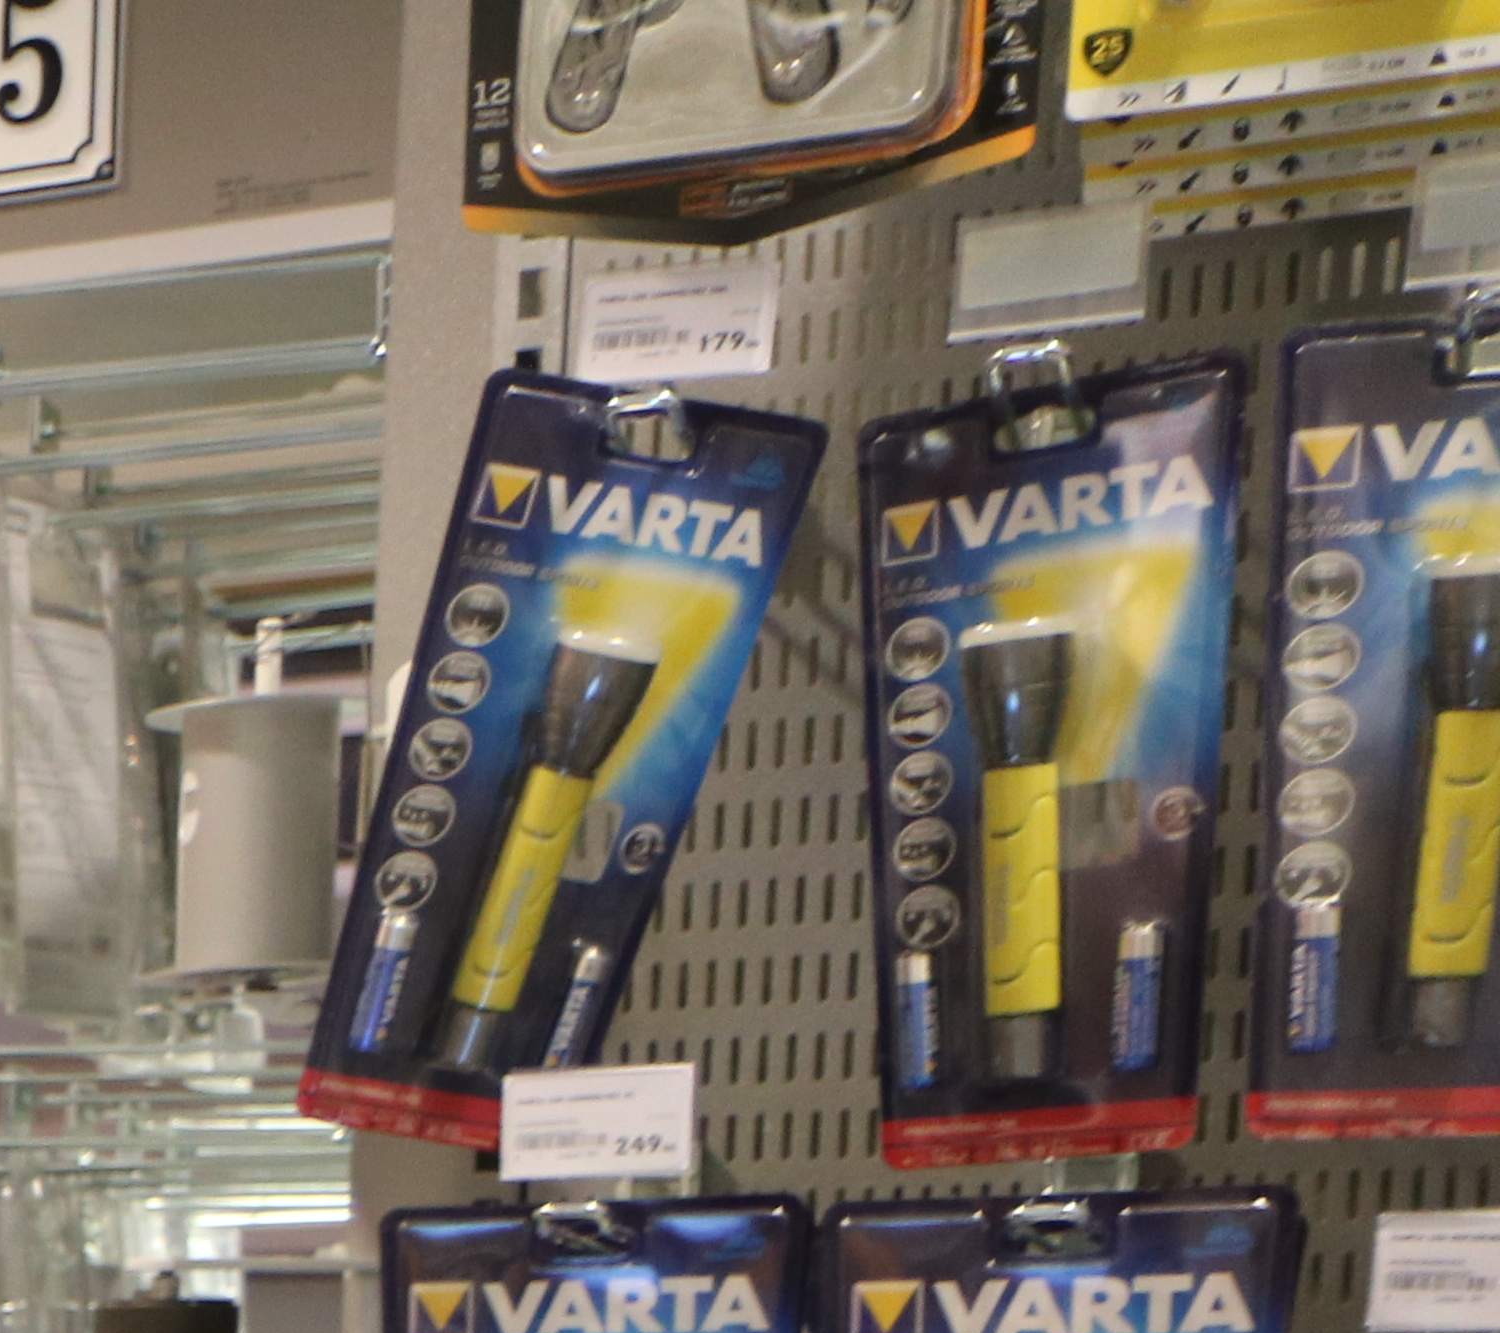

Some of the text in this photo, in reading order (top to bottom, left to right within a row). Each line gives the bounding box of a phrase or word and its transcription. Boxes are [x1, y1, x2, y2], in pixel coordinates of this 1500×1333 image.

[1091, 33, 1125, 64] 25
[473, 77, 512, 108] 12
[548, 474, 763, 568] VARTA
[946, 454, 1215, 549] VARTA
